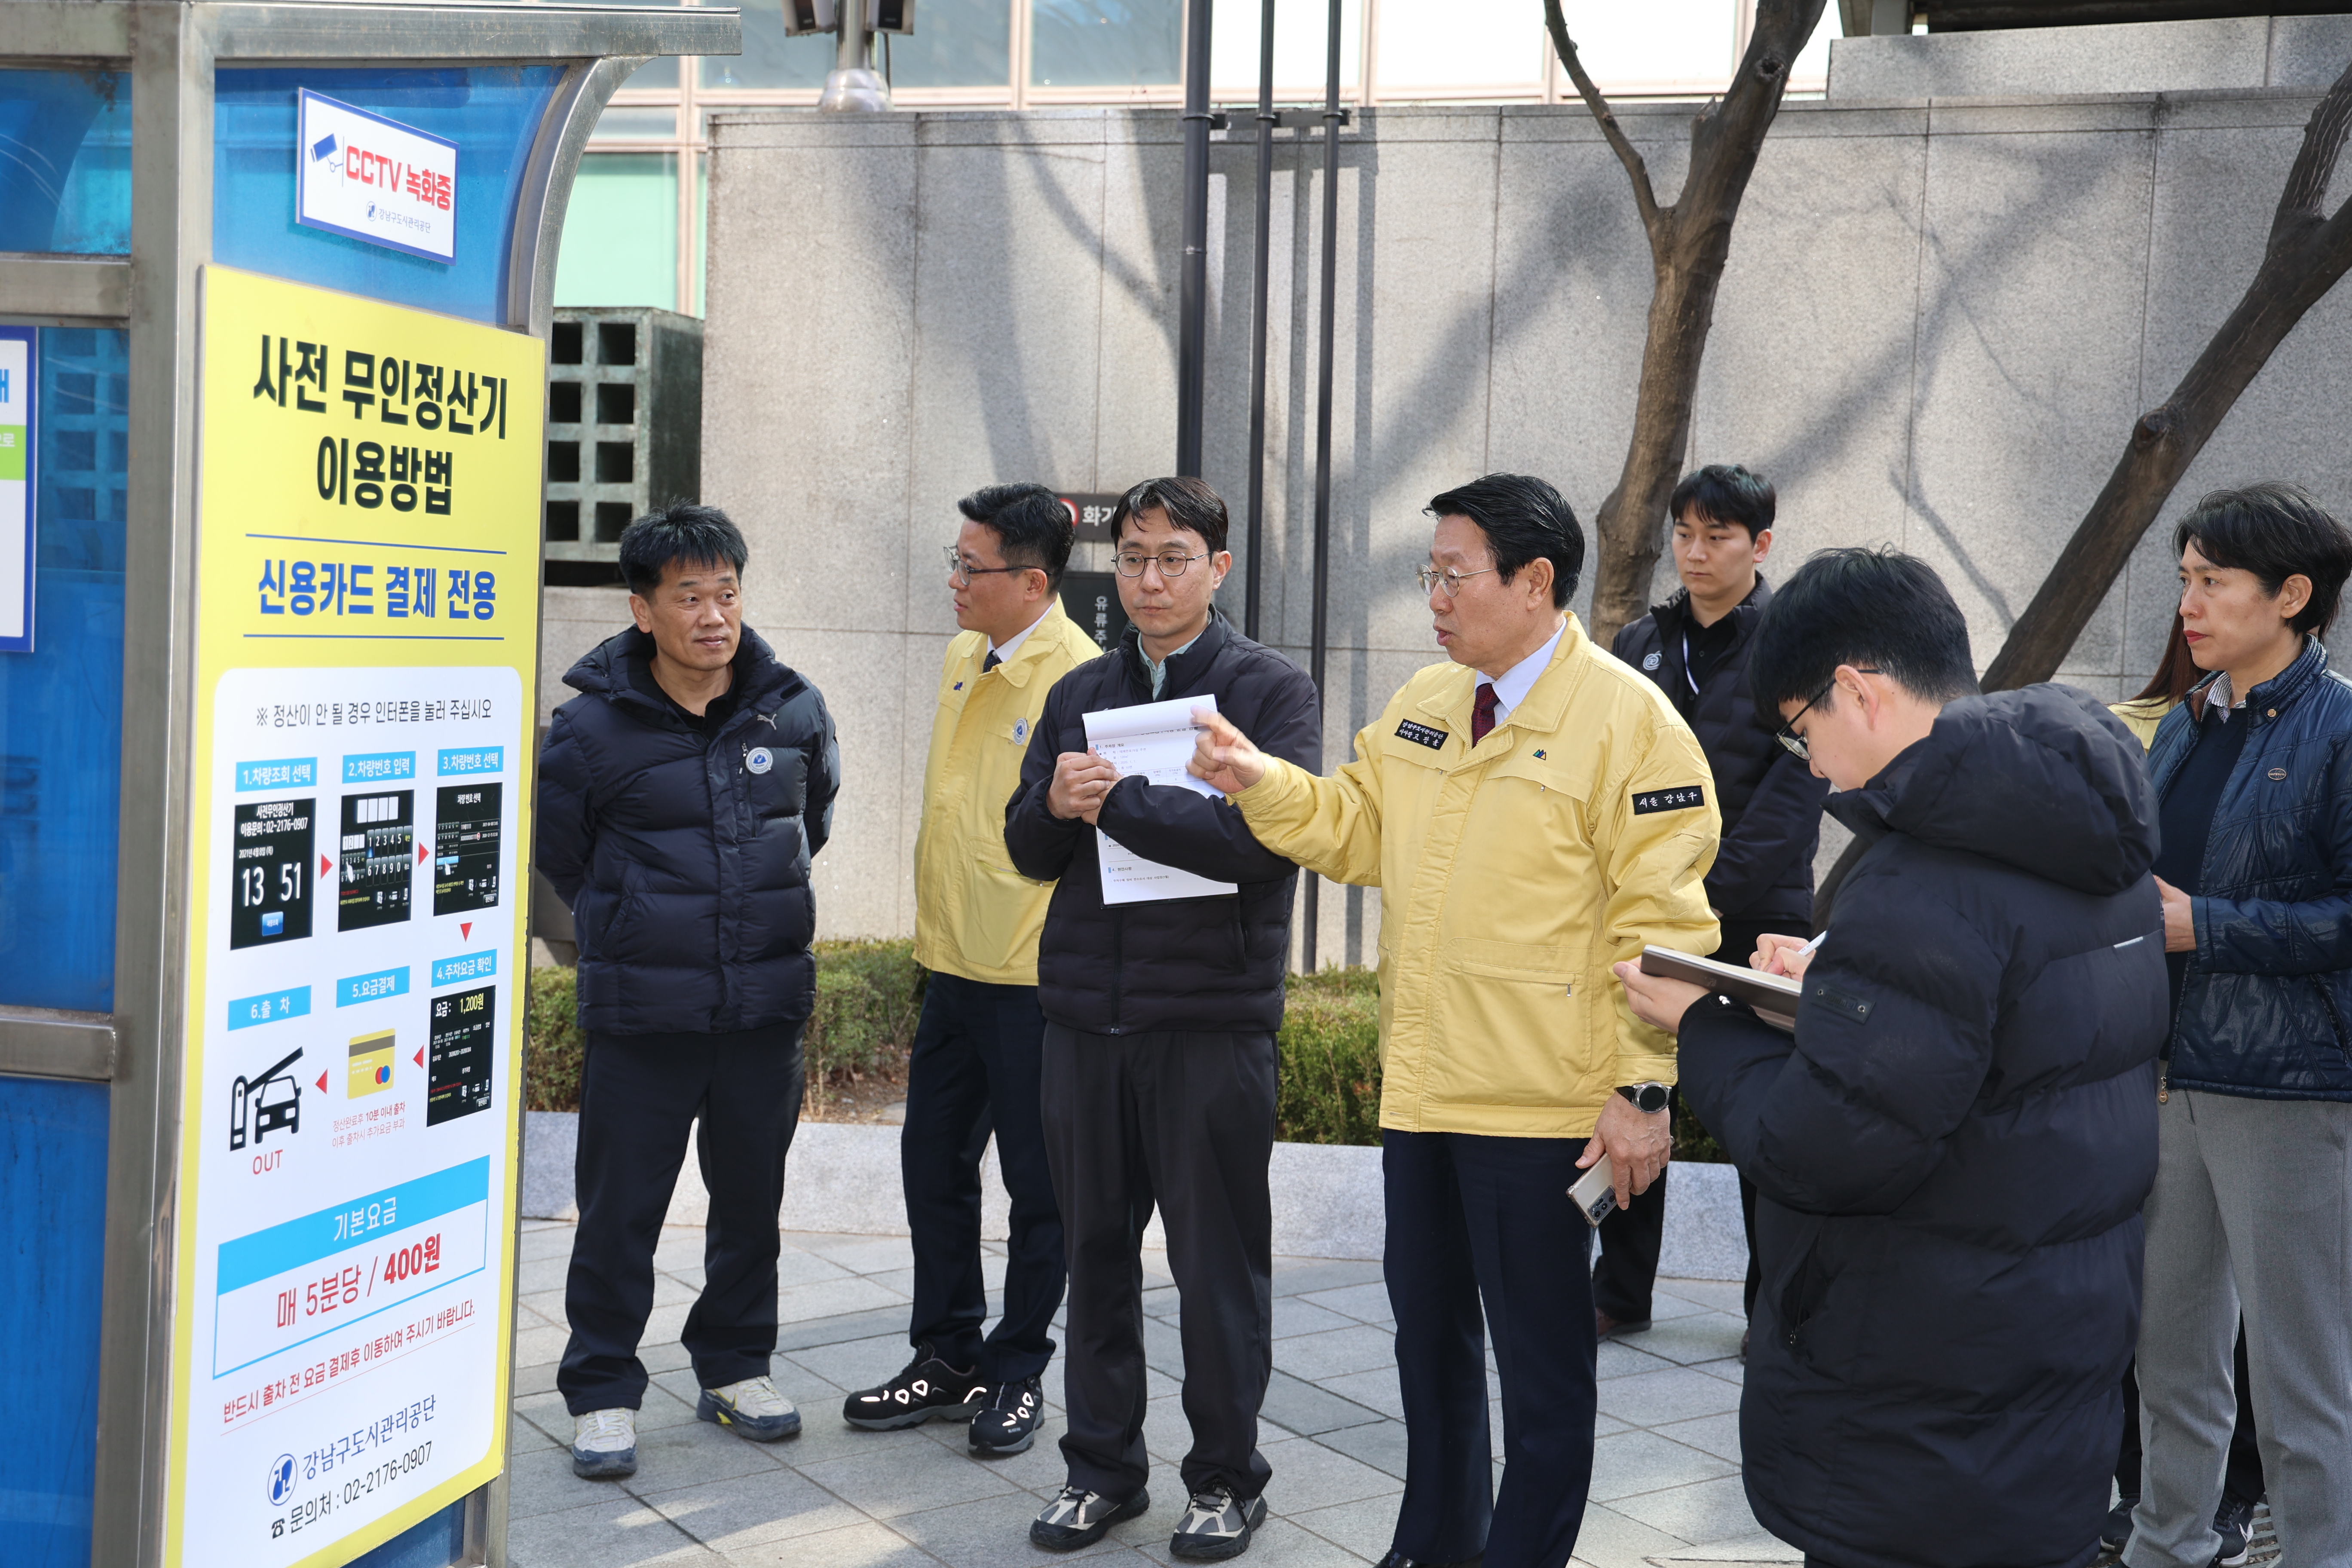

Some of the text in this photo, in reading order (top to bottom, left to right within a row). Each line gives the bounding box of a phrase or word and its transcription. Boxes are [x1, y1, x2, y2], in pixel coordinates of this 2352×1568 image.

[346, 145, 451, 211] CCTV 녹화중
[378, 208, 431, 233] 강남구도시관리공단
[253, 334, 507, 440] 사전 무인정산기
[317, 436, 452, 515] 이용방법
[258, 559, 496, 620] 신용카드 결제 전용
[1093, 596, 1109, 652] 유류주
[273, 699, 492, 727] 정산이 안 될 경우 인터폰을 눌러 주십시오
[1402, 722, 1444, 739] 강남구도시관리공단
[349, 758, 410, 777] 2.차량번호 입력
[443, 753, 499, 770] 3.차량번호 선택
[243, 764, 311, 786] 1.차량조회 선택
[257, 802, 294, 819] 사전무인정산기
[457, 793, 481, 805] 차량 번호 선택
[1639, 792, 1697, 808] 서울 강남구
[369, 837, 372, 847] 1
[376, 836, 380, 846] 2
[383, 835, 387, 845] 3
[390, 834, 394, 844] 4
[398, 833, 401, 844] 5
[239, 848, 252, 858] 2021년
[368, 866, 372, 876] 6
[375, 865, 379, 875] 7
[383, 864, 386, 874] 8
[390, 863, 393, 873] 9
[397, 862, 401, 872] 0
[242, 862, 301, 907] 13 51
[437, 956, 492, 980] 4.주차요금 확인
[352, 975, 395, 998] 5.요금결제
[251, 996, 290, 1019] 6.출 차
[460, 993, 484, 1014] 1,200원
[333, 1101, 406, 1133] 정산완료후 10분 이내 출차
[332, 1118, 405, 1149] 이후 출차시 추가요금 부과
[252, 1149, 283, 1175] OUT
[334, 1196, 397, 1241] 기본요금
[277, 1232, 441, 1328] 매 5분당 / 400원
[224, 1298, 475, 1424] 반드시 출차 전 요금 결제후 이동하여 주시기 바랍니다.
[303, 1394, 436, 1479] 강남구도시관리공단
[290, 1490, 332, 1534] 문의처
[344, 1440, 432, 1504] 02-2176-0907
